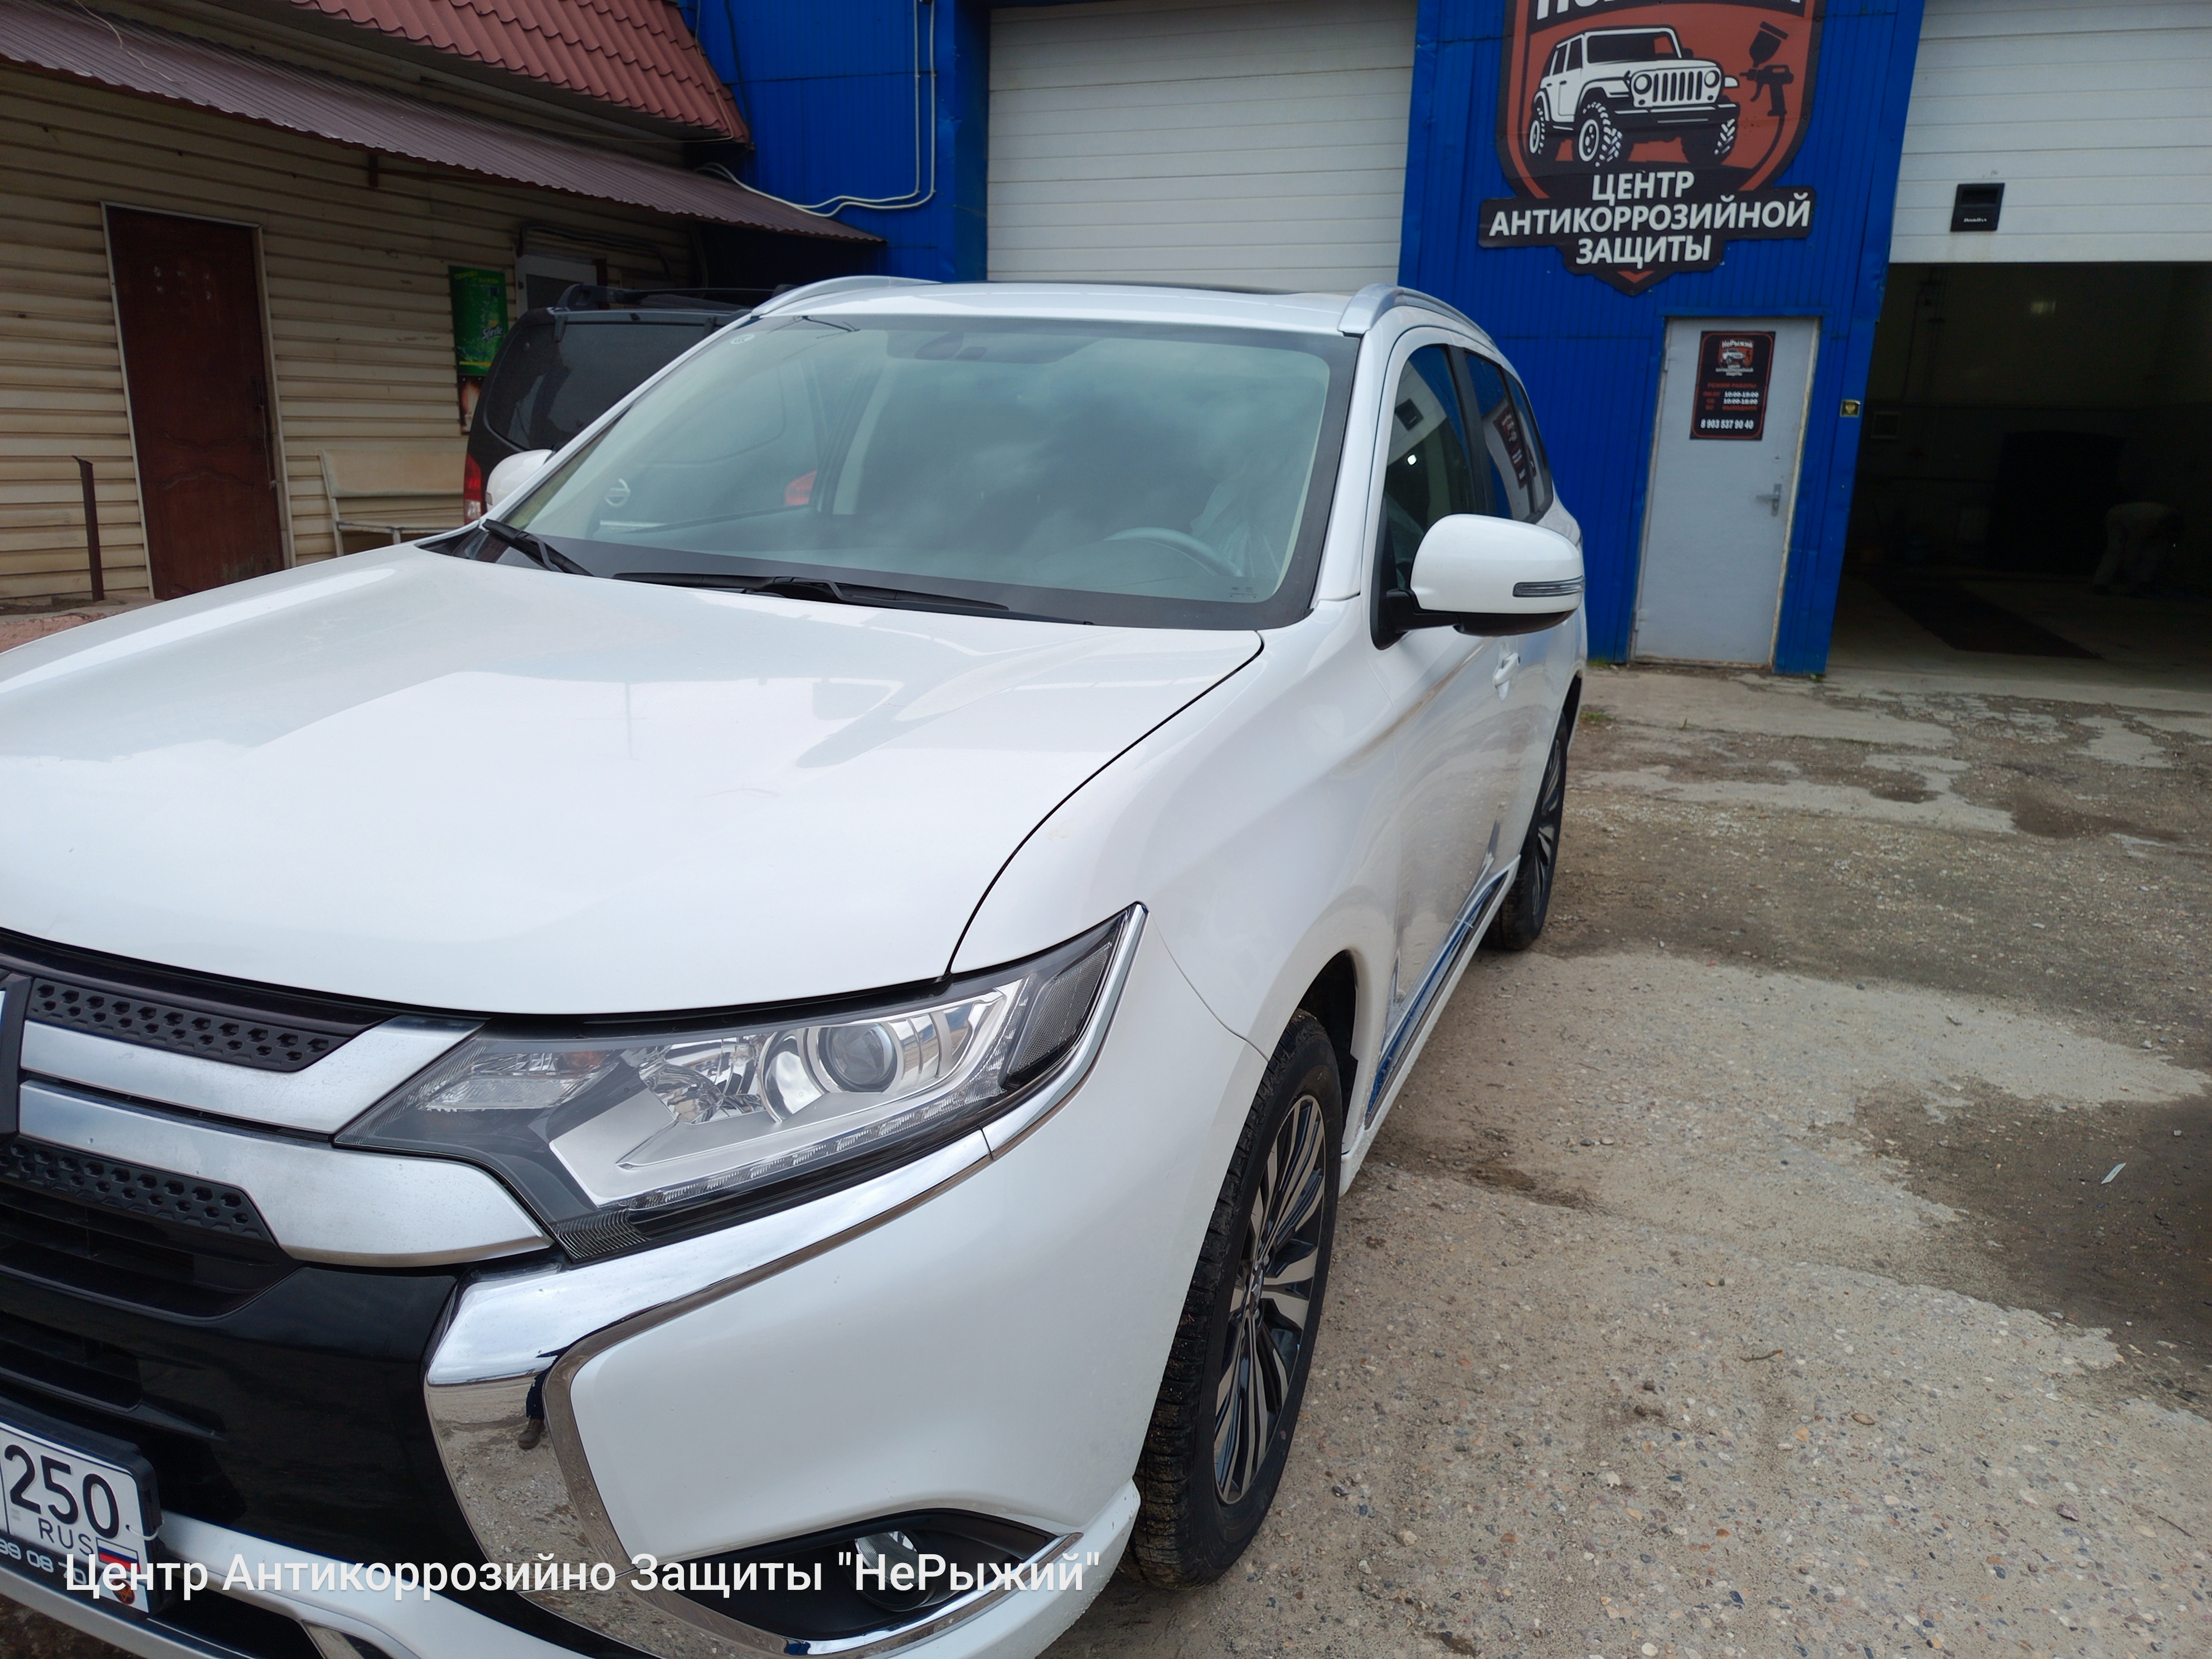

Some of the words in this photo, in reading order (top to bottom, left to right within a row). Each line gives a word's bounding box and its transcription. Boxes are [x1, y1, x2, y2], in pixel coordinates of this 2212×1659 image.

[1592, 171, 1695, 206] ЦЕНТР
[1489, 192, 1811, 236] АНТИКОРРОЗИЙНОЙ
[1576, 235, 1711, 269] ЗАЩИТЫ
[4, 1444, 119, 1539] 250
[38, 1517, 94, 1556] RUS
[26, 1550, 54, 1573] 08
